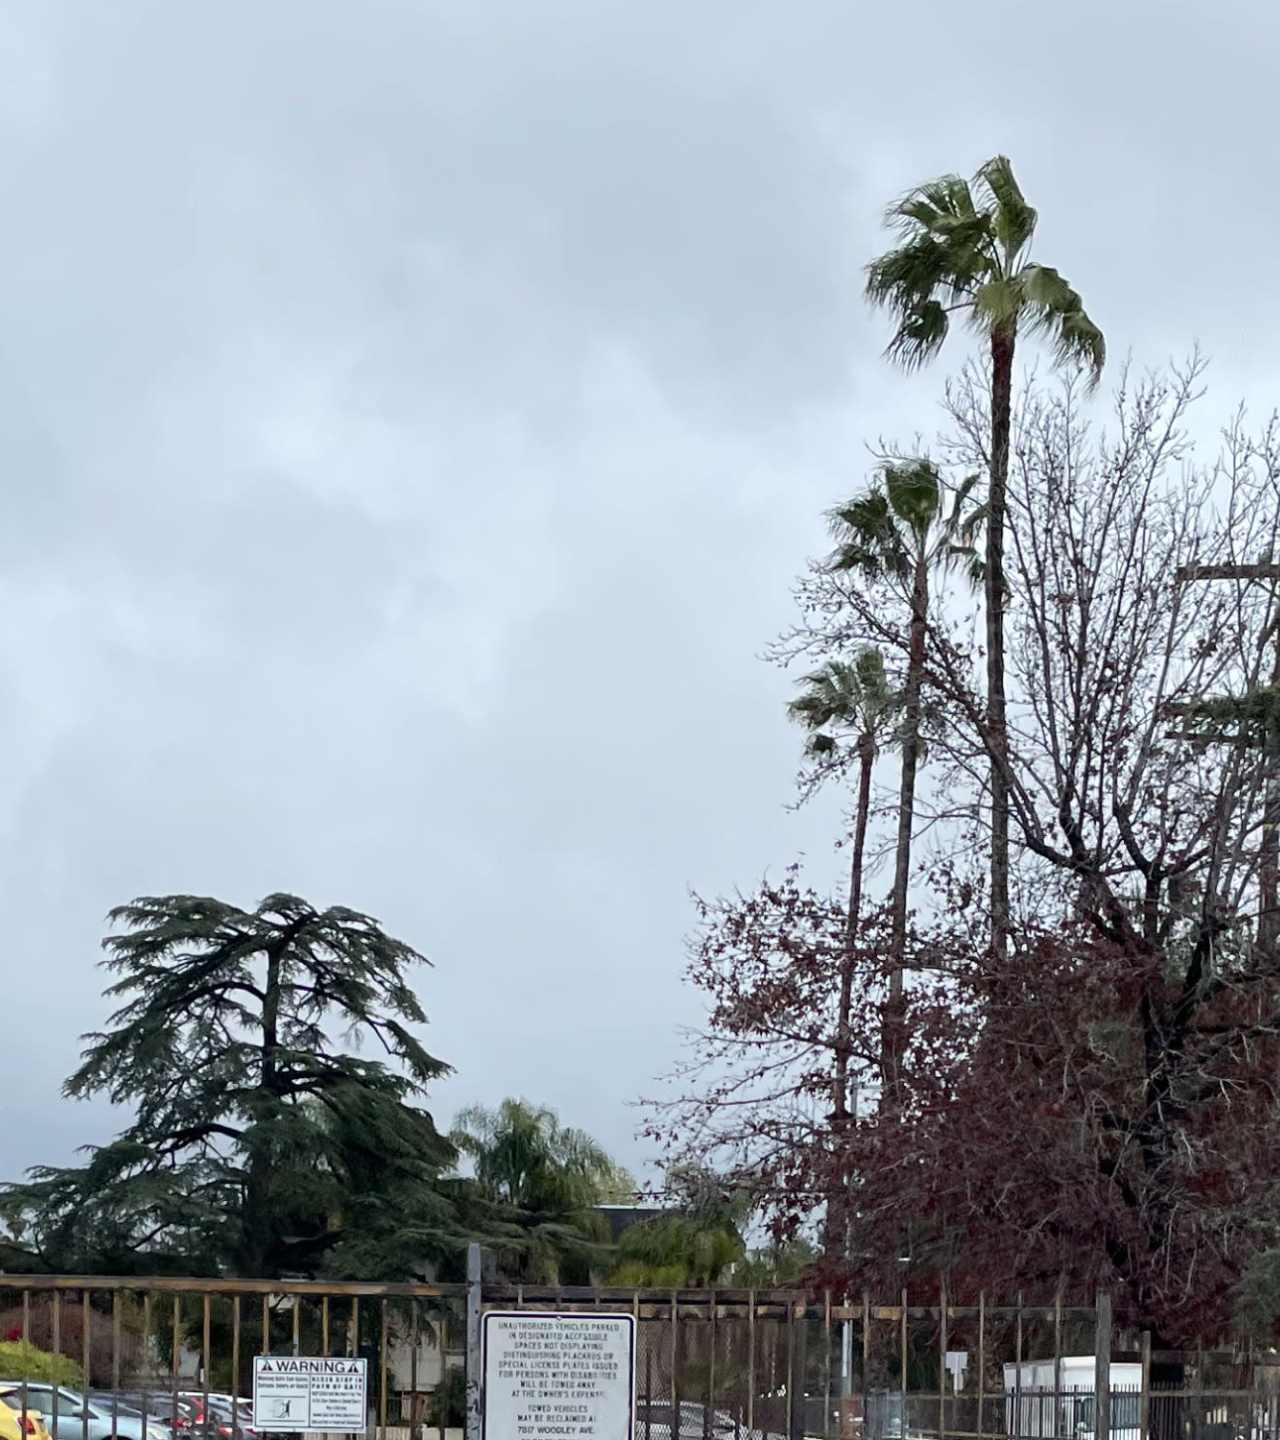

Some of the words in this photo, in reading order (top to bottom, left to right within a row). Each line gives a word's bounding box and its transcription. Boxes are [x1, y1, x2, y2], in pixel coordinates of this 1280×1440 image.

[560, 1342, 603, 1350] DISPLAYING
[563, 1352, 601, 1360] PLACARDS
[276, 1361, 346, 1373] WARNING
[563, 1361, 590, 1369] PLATES
[592, 1362, 618, 1370] ISSUED
[498, 1370, 513, 1378] FOR
[551, 1381, 575, 1389] TOWED
[538, 1390, 569, 1398] OWNER'S
[528, 1404, 552, 1412] TOWED
[517, 1414, 532, 1422] MAY
[534, 1414, 544, 1422] BE
[537, 1426, 576, 1434] WOODLEY
